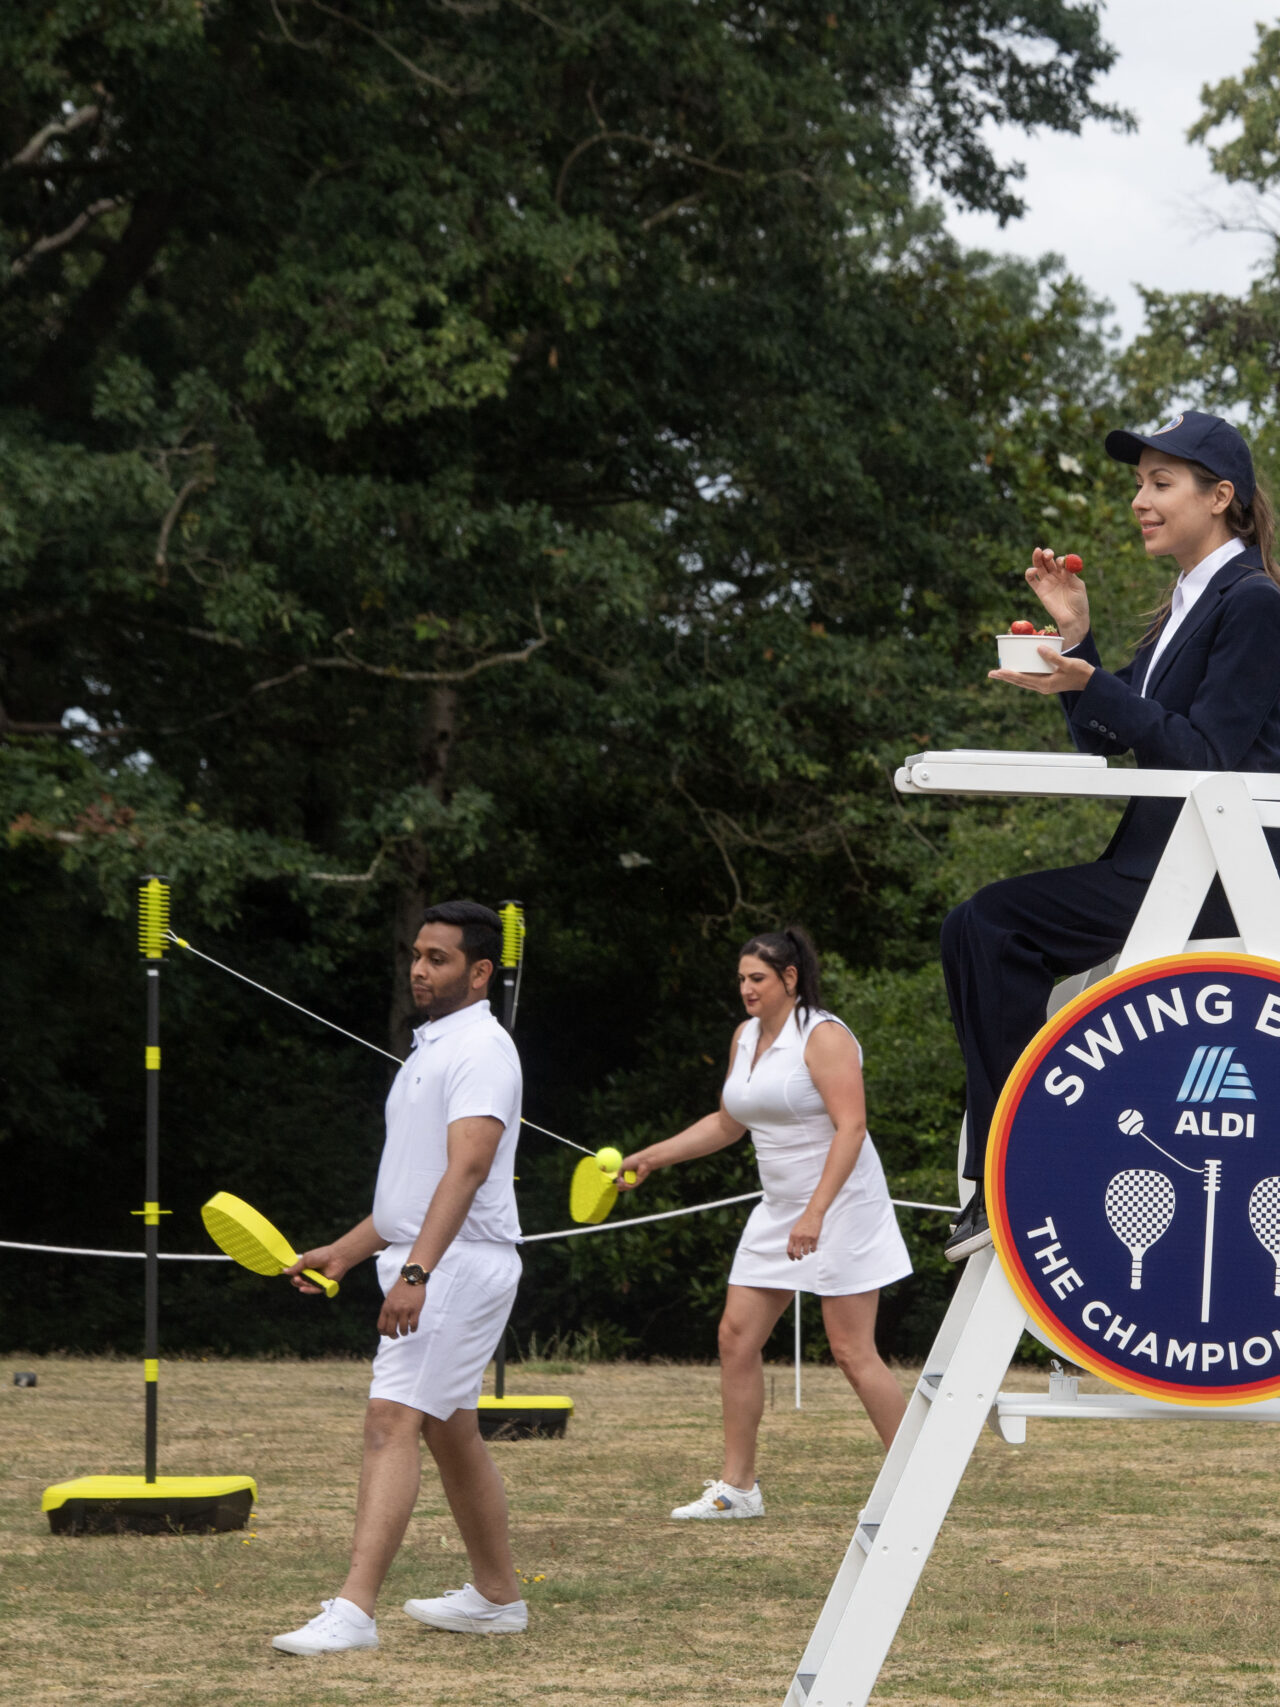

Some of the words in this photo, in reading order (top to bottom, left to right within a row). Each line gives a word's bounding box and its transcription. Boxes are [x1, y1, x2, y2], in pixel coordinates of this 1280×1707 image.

[1044, 984, 1233, 1106] SWING
[1174, 1110, 1255, 1138] ALDI
[1026, 1216, 1085, 1301] THE
